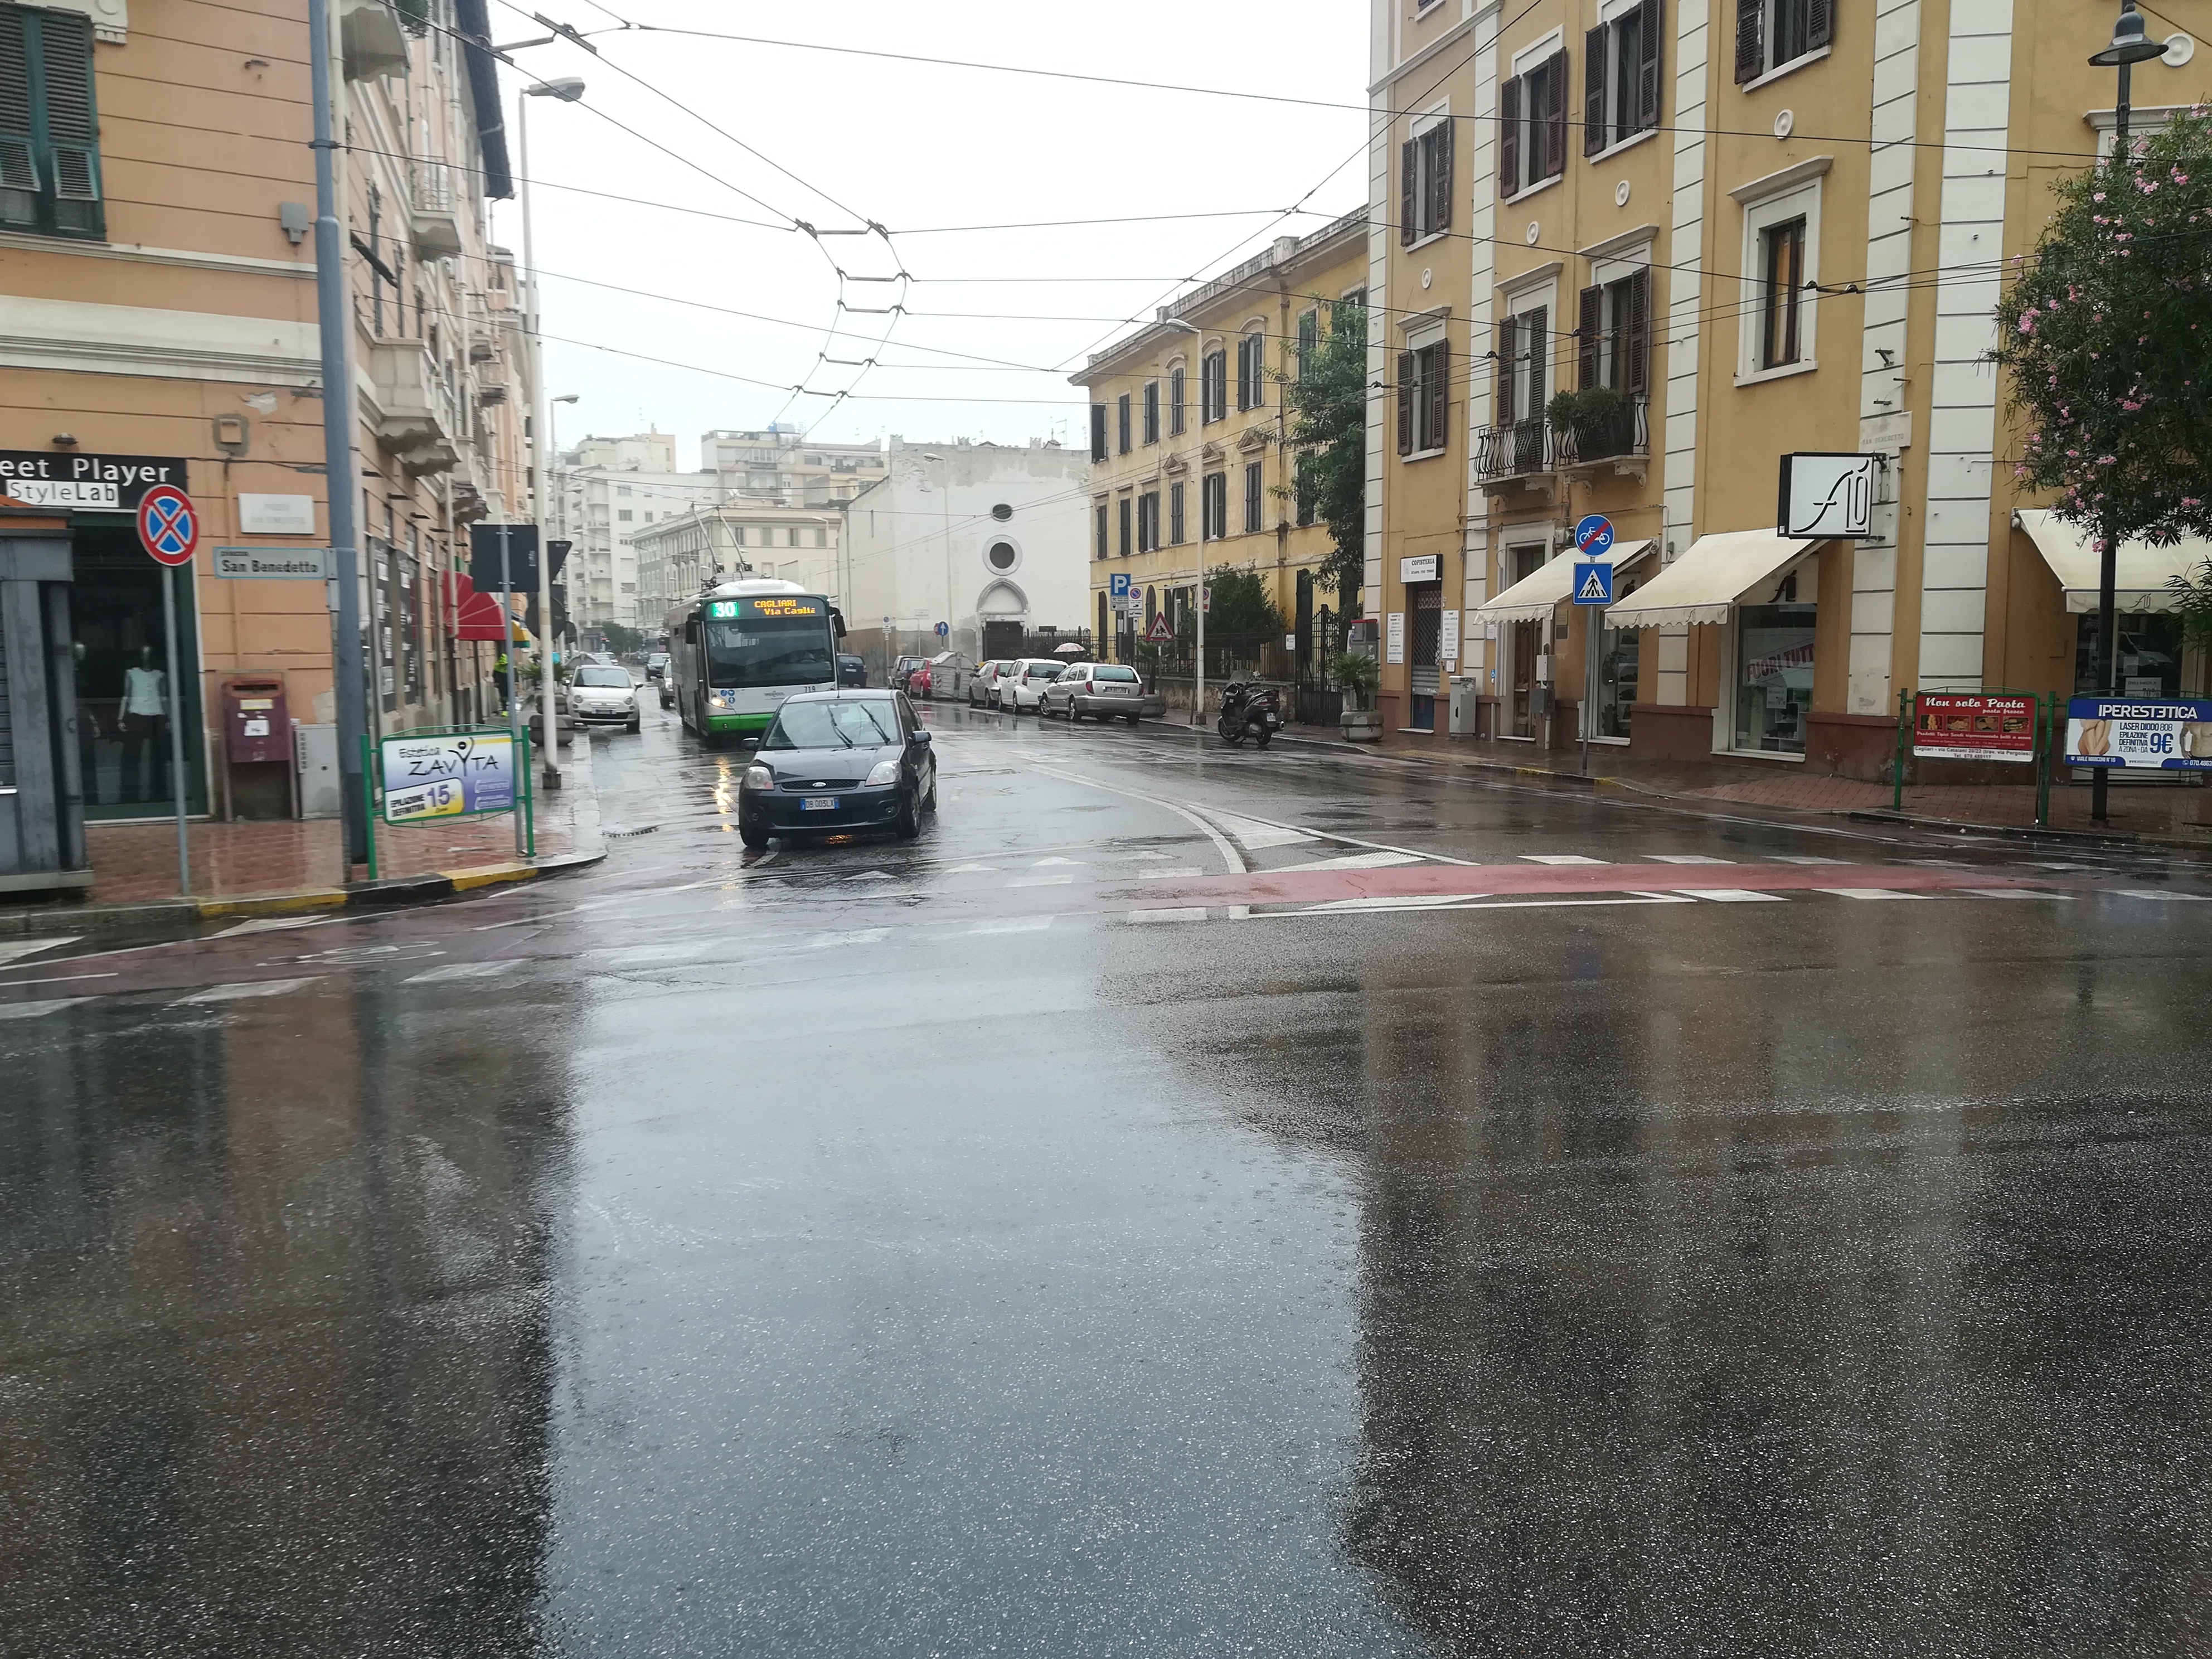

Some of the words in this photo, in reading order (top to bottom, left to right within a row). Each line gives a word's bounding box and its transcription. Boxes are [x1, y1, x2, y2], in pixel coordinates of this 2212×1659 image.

[72, 458, 169, 487] Player
[9, 482, 116, 503] StyleLab
[221, 559, 247, 573] San
[251, 559, 319, 573] Benedetto
[1114, 575, 1127, 594] P
[715, 601, 736, 617] 30
[754, 599, 797, 608] CAGLIARI
[804, 685, 816, 693] 719
[1925, 697, 1951, 707] Non
[1955, 699, 1982, 708] solo
[1986, 698, 2026, 709] Pasta
[2119, 722, 2140, 731] LASER
[2140, 722, 2159, 731] DIODO
[2160, 723, 2173, 731] 808
[2119, 731, 2148, 739] EPILAZIONE
[2150, 733, 2174, 754] 9€
